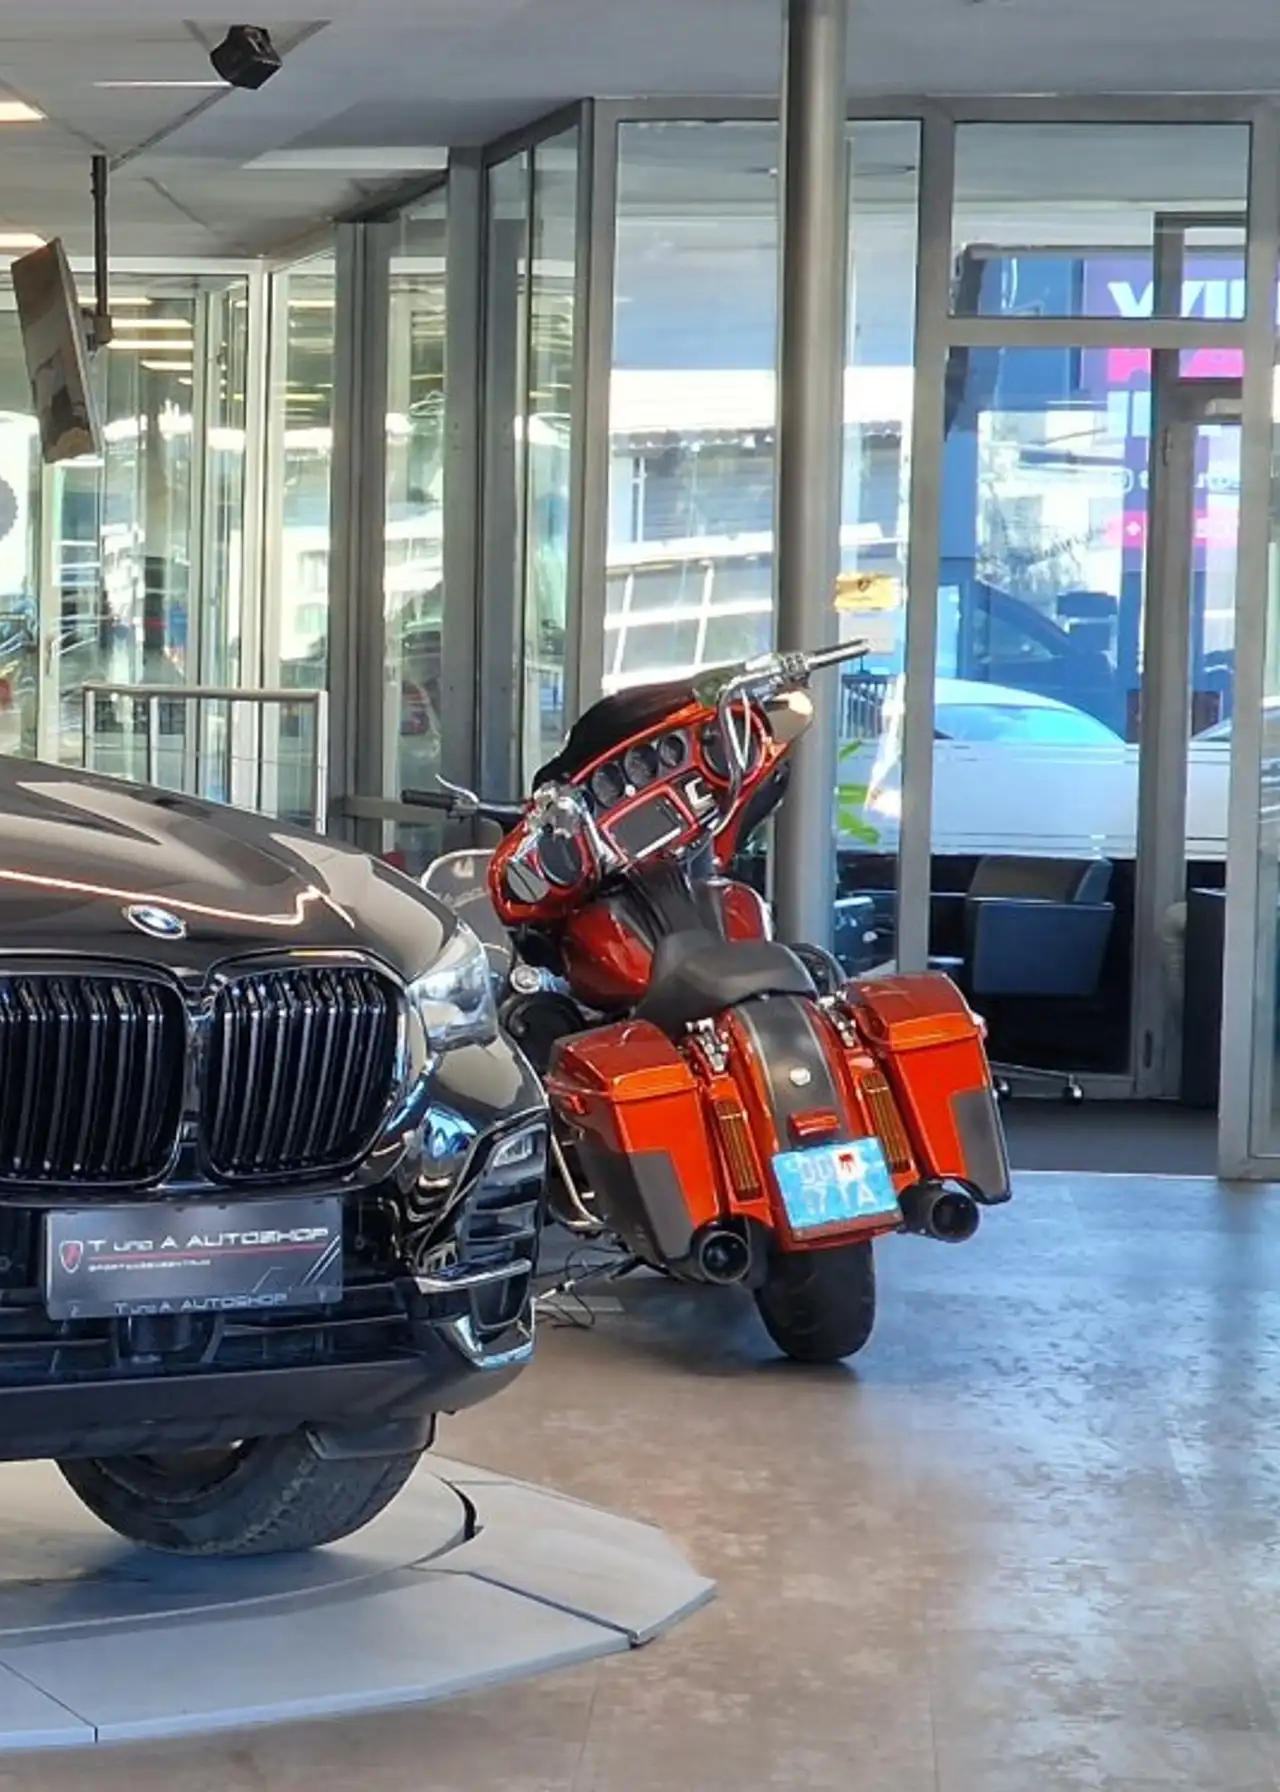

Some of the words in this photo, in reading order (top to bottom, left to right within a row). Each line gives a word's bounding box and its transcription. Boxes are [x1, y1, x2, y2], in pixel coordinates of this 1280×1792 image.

[87, 1239, 107, 1253] T
[160, 1235, 178, 1249] A
[186, 1228, 329, 1248] AUTOSHOP
[114, 1302, 128, 1315] T
[159, 1300, 172, 1314] A
[180, 1292, 288, 1311] AUTOSHOP
